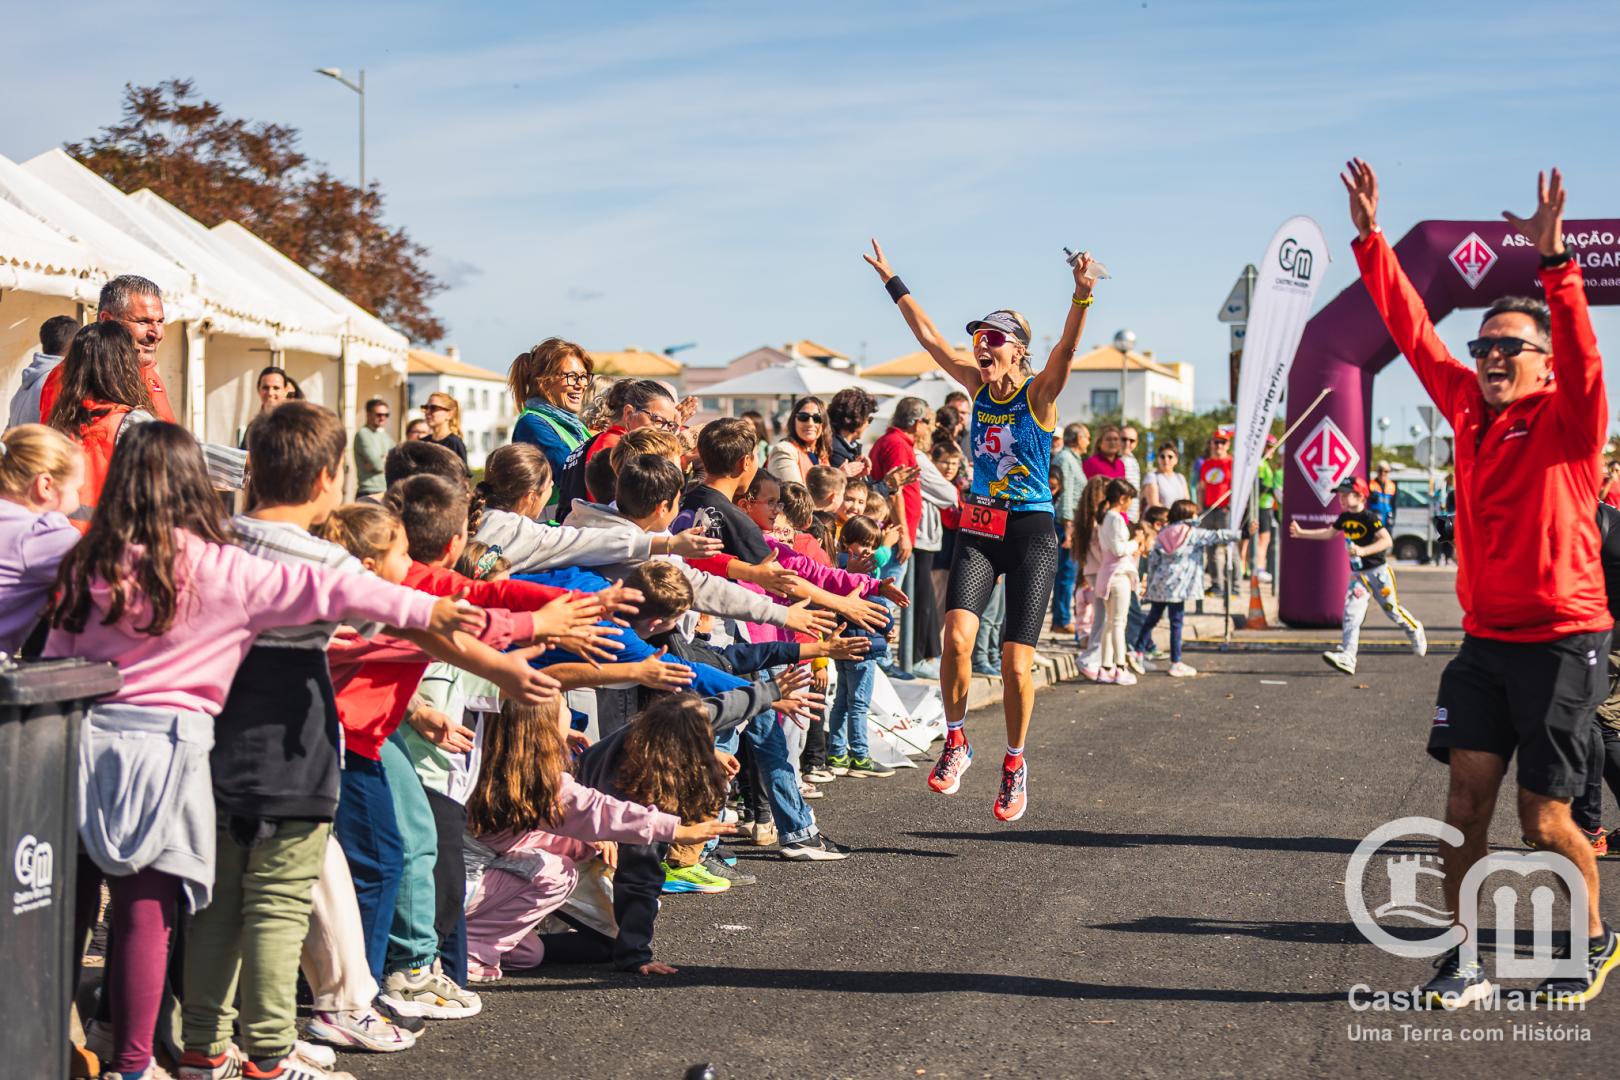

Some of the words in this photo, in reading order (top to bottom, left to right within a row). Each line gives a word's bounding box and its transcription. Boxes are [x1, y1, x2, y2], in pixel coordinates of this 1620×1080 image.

[1502, 230, 1614, 248] ASAÇÃO
[1573, 252, 1620, 267] LGA
[1263, 363, 1285, 412] Marim
[977, 410, 1015, 425] EUROPE
[986, 427, 1002, 453] 5
[971, 507, 992, 526] 50
